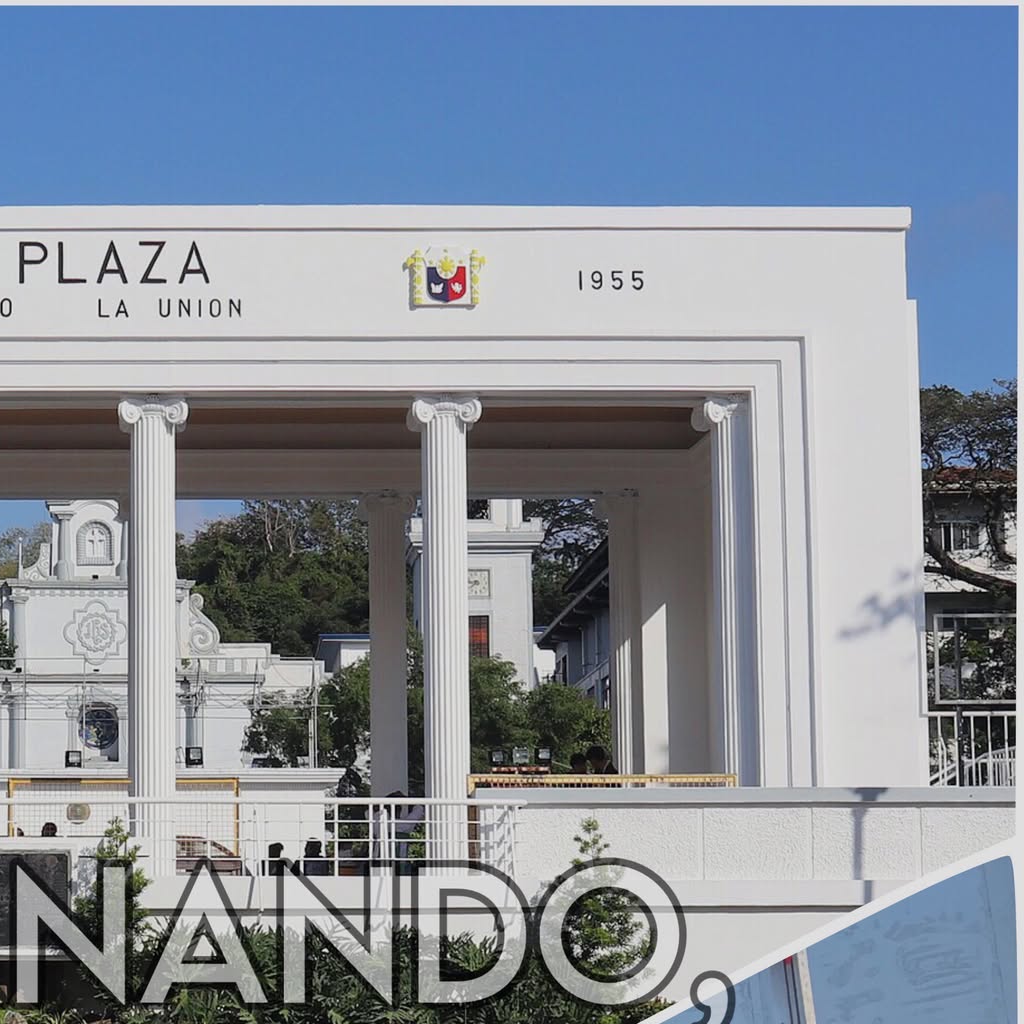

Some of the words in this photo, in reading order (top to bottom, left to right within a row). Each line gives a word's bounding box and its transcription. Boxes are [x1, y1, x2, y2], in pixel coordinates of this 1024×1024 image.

[19, 240, 210, 283] PLAZA
[578, 270, 644, 290] 1955
[98, 298, 130, 319] LA
[159, 298, 243, 319] UNION
